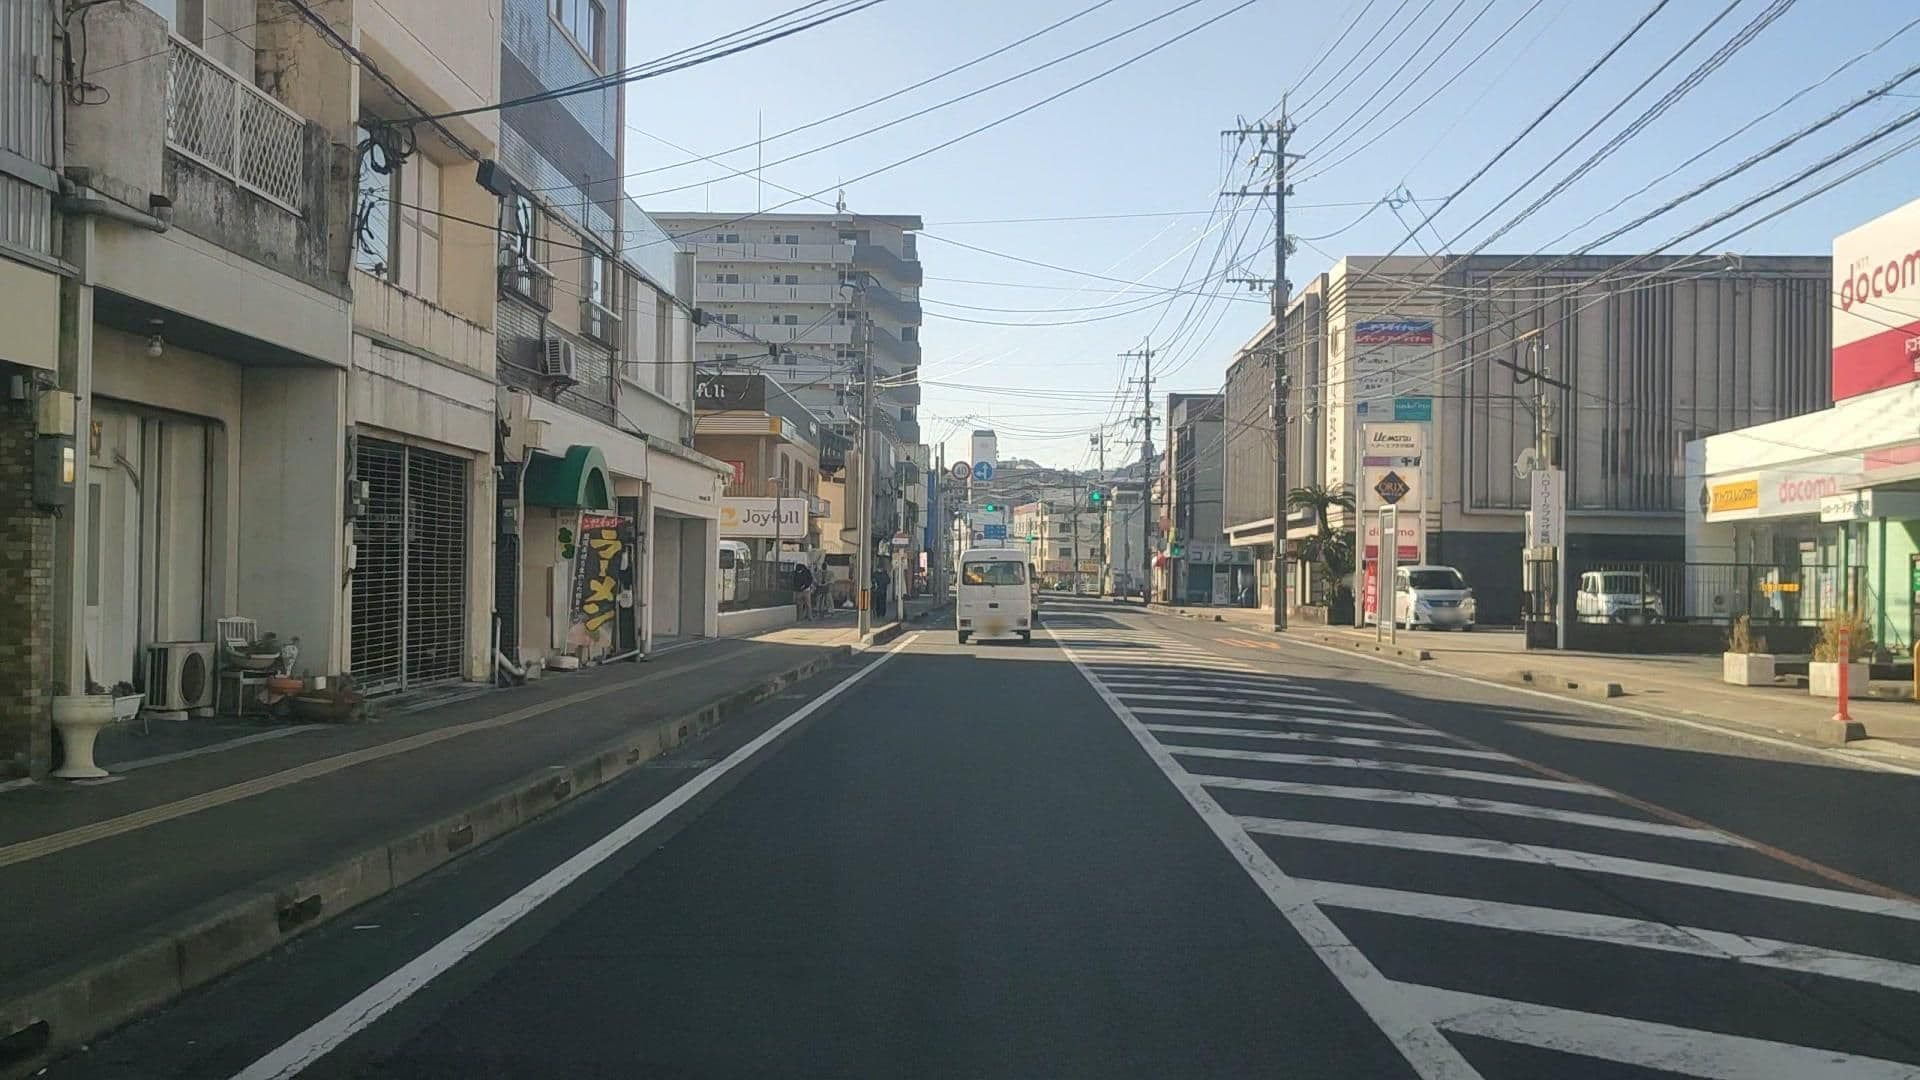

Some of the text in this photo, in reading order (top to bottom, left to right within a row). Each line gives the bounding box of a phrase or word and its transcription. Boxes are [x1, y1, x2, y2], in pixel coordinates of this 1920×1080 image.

[1378, 482, 1406, 492] ORIX
[742, 508, 800, 527] Joyfull
[583, 528, 622, 632] ラーメン
